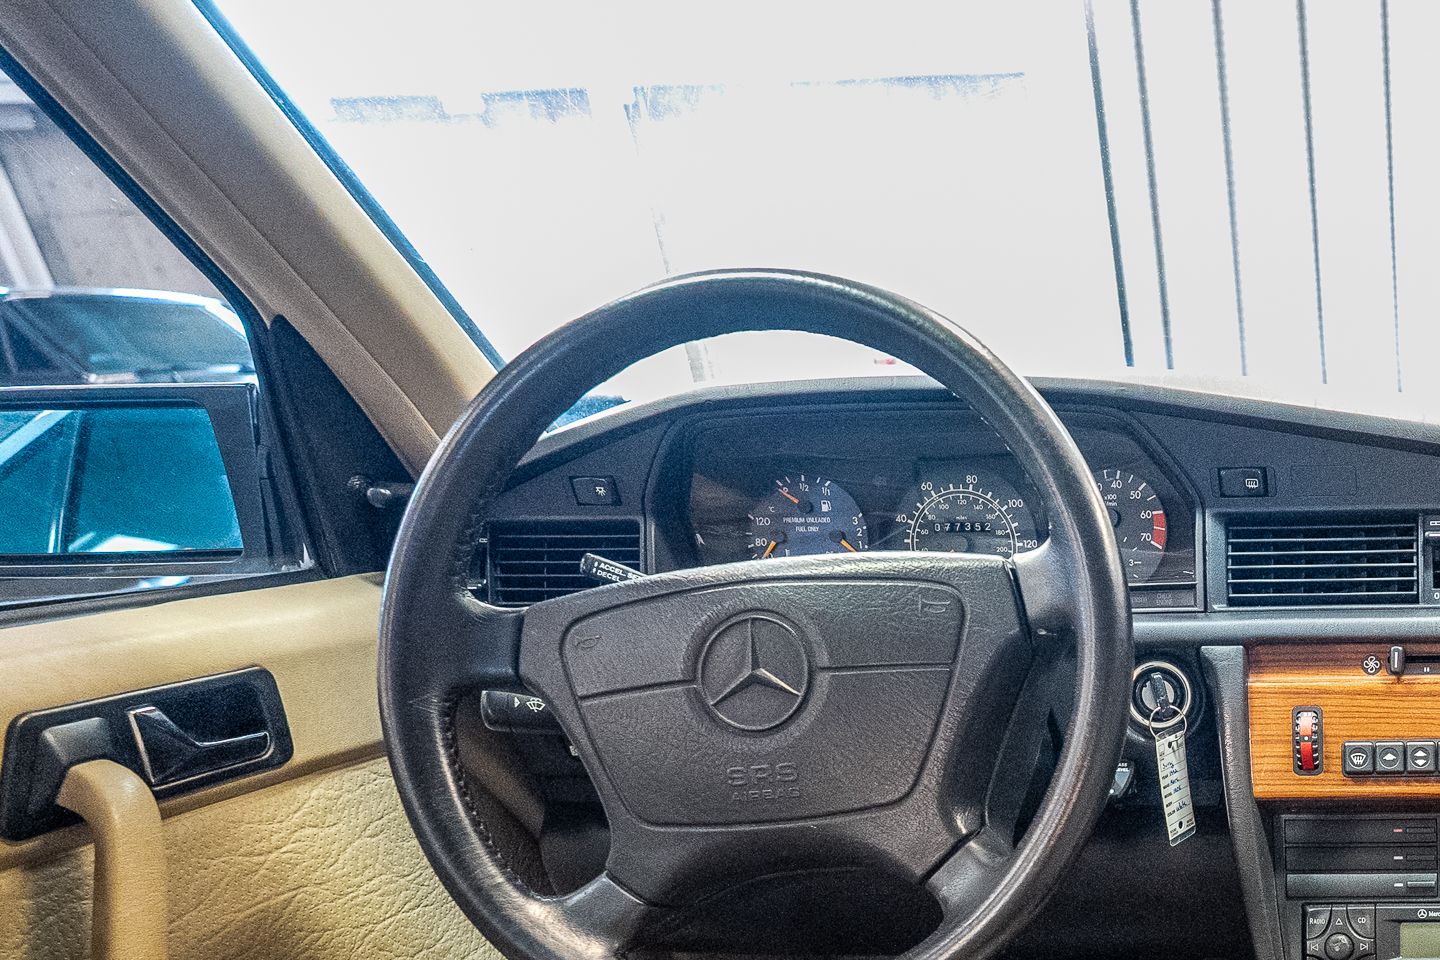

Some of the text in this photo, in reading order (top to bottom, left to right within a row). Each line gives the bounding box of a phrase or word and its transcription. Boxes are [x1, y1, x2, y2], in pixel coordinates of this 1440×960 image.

[966, 475, 978, 484] 80
[800, 483, 809, 492] 1/2
[921, 482, 933, 491] 60
[1110, 480, 1122, 489] 40
[1129, 490, 1142, 500] 50
[1008, 499, 1024, 508] 100
[895, 514, 907, 523] 40
[1140, 510, 1153, 519] 60
[755, 517, 771, 526] 120
[852, 516, 859, 525] 3
[856, 528, 863, 537] 2
[1140, 533, 1152, 541] 70
[755, 538, 768, 547] 80
[1023, 539, 1038, 548] 120
[726, 761, 798, 786] SRS
[1309, 917, 1326, 925] RADIO
